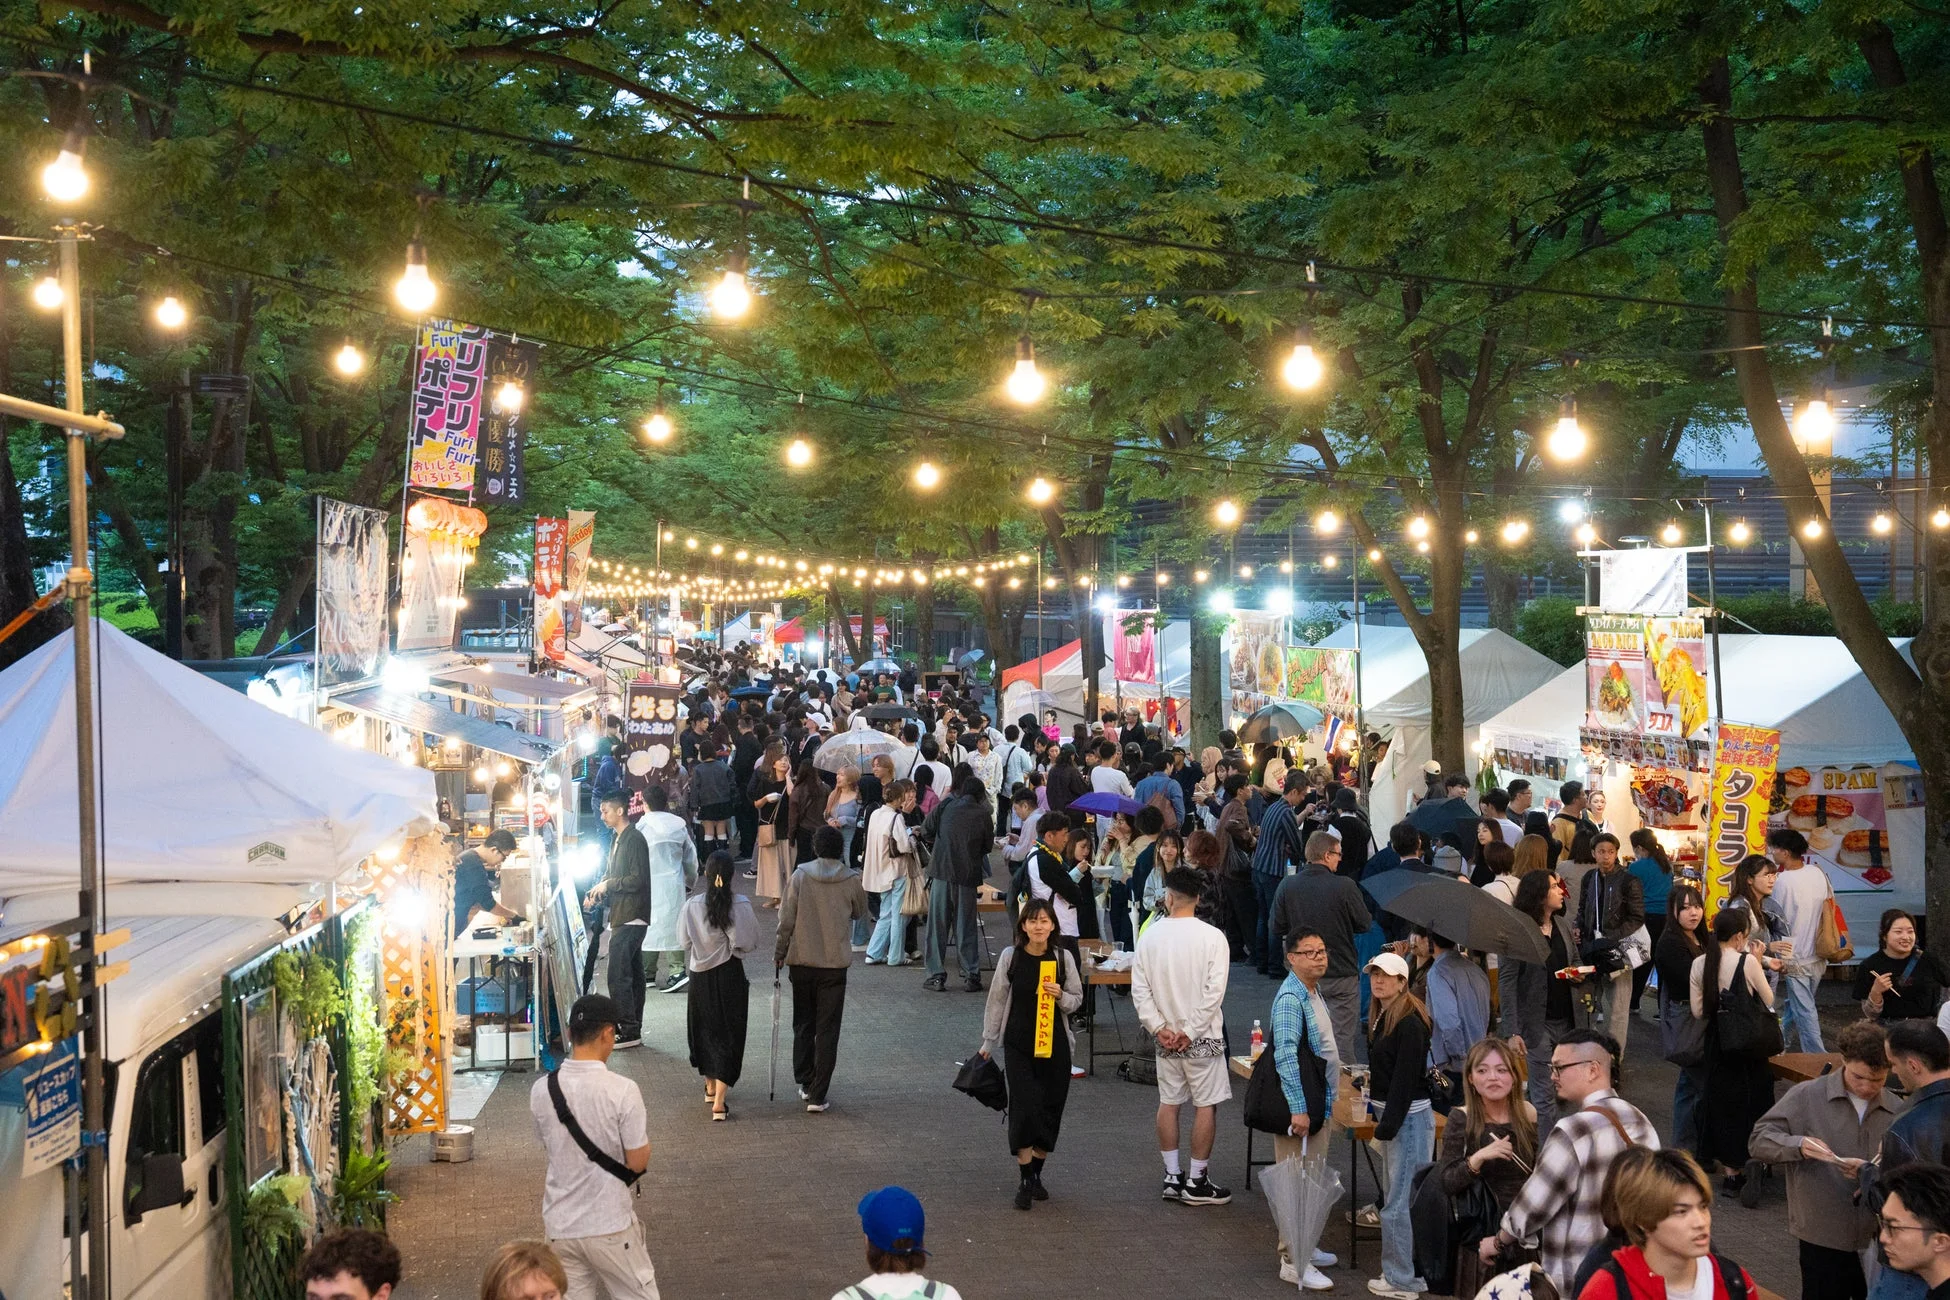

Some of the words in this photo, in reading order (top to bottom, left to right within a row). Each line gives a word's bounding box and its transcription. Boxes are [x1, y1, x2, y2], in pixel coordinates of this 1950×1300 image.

[415, 359, 451, 446] ポテト
[444, 431, 474, 449] Furi
[446, 446, 476, 465] Furi
[413, 460, 457, 471] おいしさ
[1670, 621, 1703, 639] TACOS
[631, 695, 676, 720] 光る
[629, 720, 675, 734] わたあめ
[1824, 772, 1878, 789] SPAM
[1715, 768, 1755, 908] タコライ
